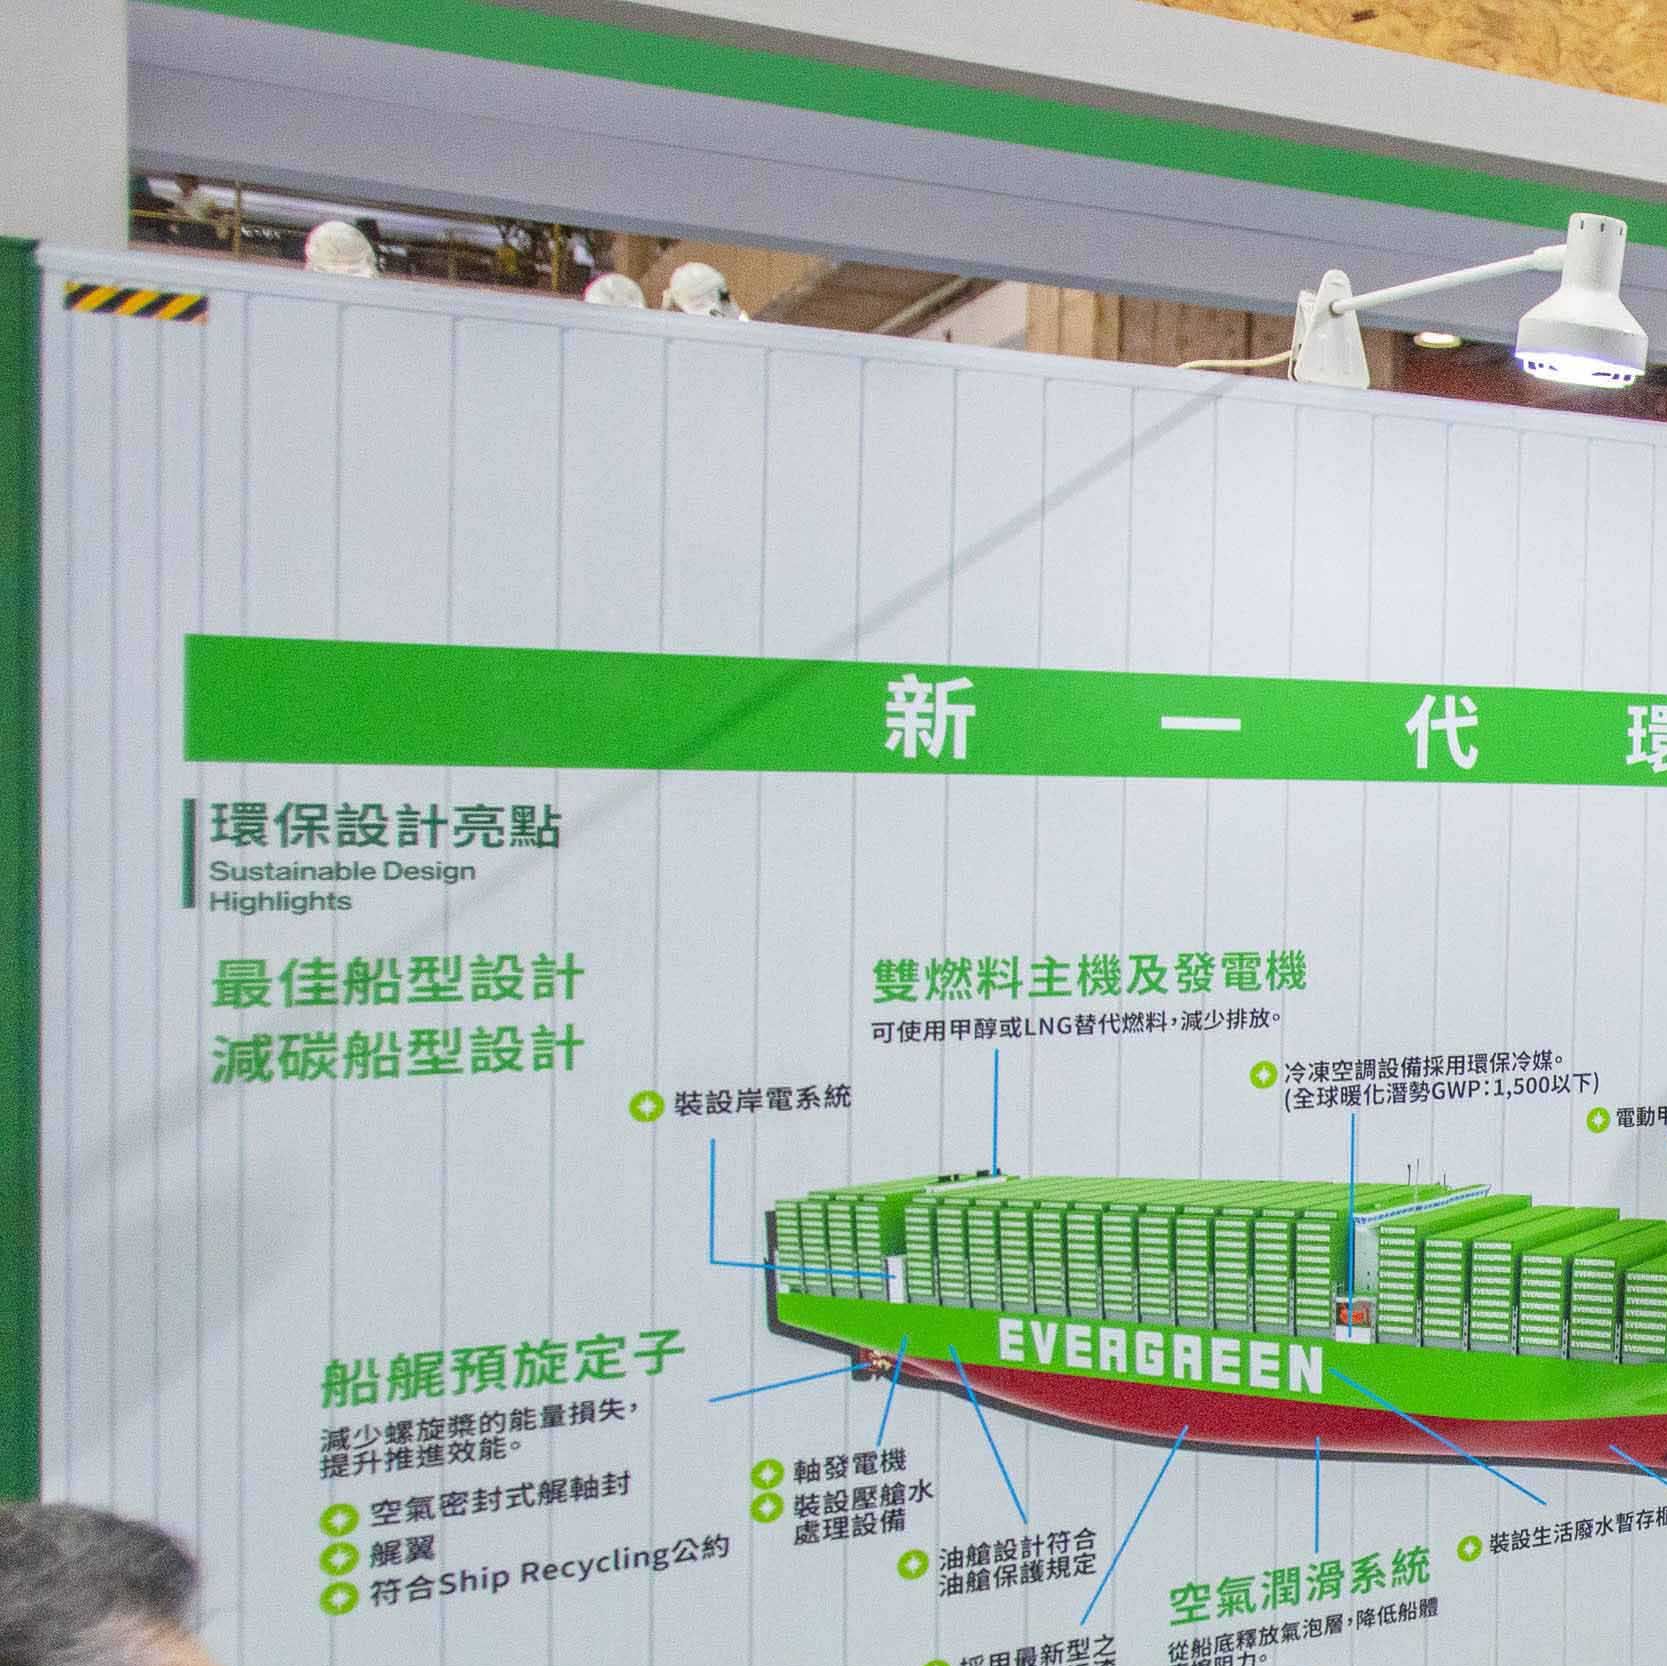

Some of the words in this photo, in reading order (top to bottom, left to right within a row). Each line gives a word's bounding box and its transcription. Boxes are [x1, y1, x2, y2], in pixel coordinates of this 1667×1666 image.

[209, 801, 562, 850] 環保設計亮點
[209, 860, 376, 882] Sustainable
[383, 861, 477, 885] Design
[209, 890, 353, 915] Highlights
[211, 952, 585, 1009] 最佳船型設計
[872, 948, 1308, 1004] 雙燃料主機及發電機
[210, 1024, 585, 1085] 減碳船型設計
[673, 1082, 853, 1117] 裝設岸電系統
[999, 1317, 1324, 1396] EVERGREEN
[793, 1446, 908, 1486] 軸發電機
[793, 1509, 907, 1546] 處理設備
[938, 1526, 1097, 1573] 油艙設計符合
[369, 1567, 510, 1608] 符合Ship
[520, 1533, 731, 1586] Recycling公約
[1168, 1544, 1433, 1628] 空氣潤滑系統
